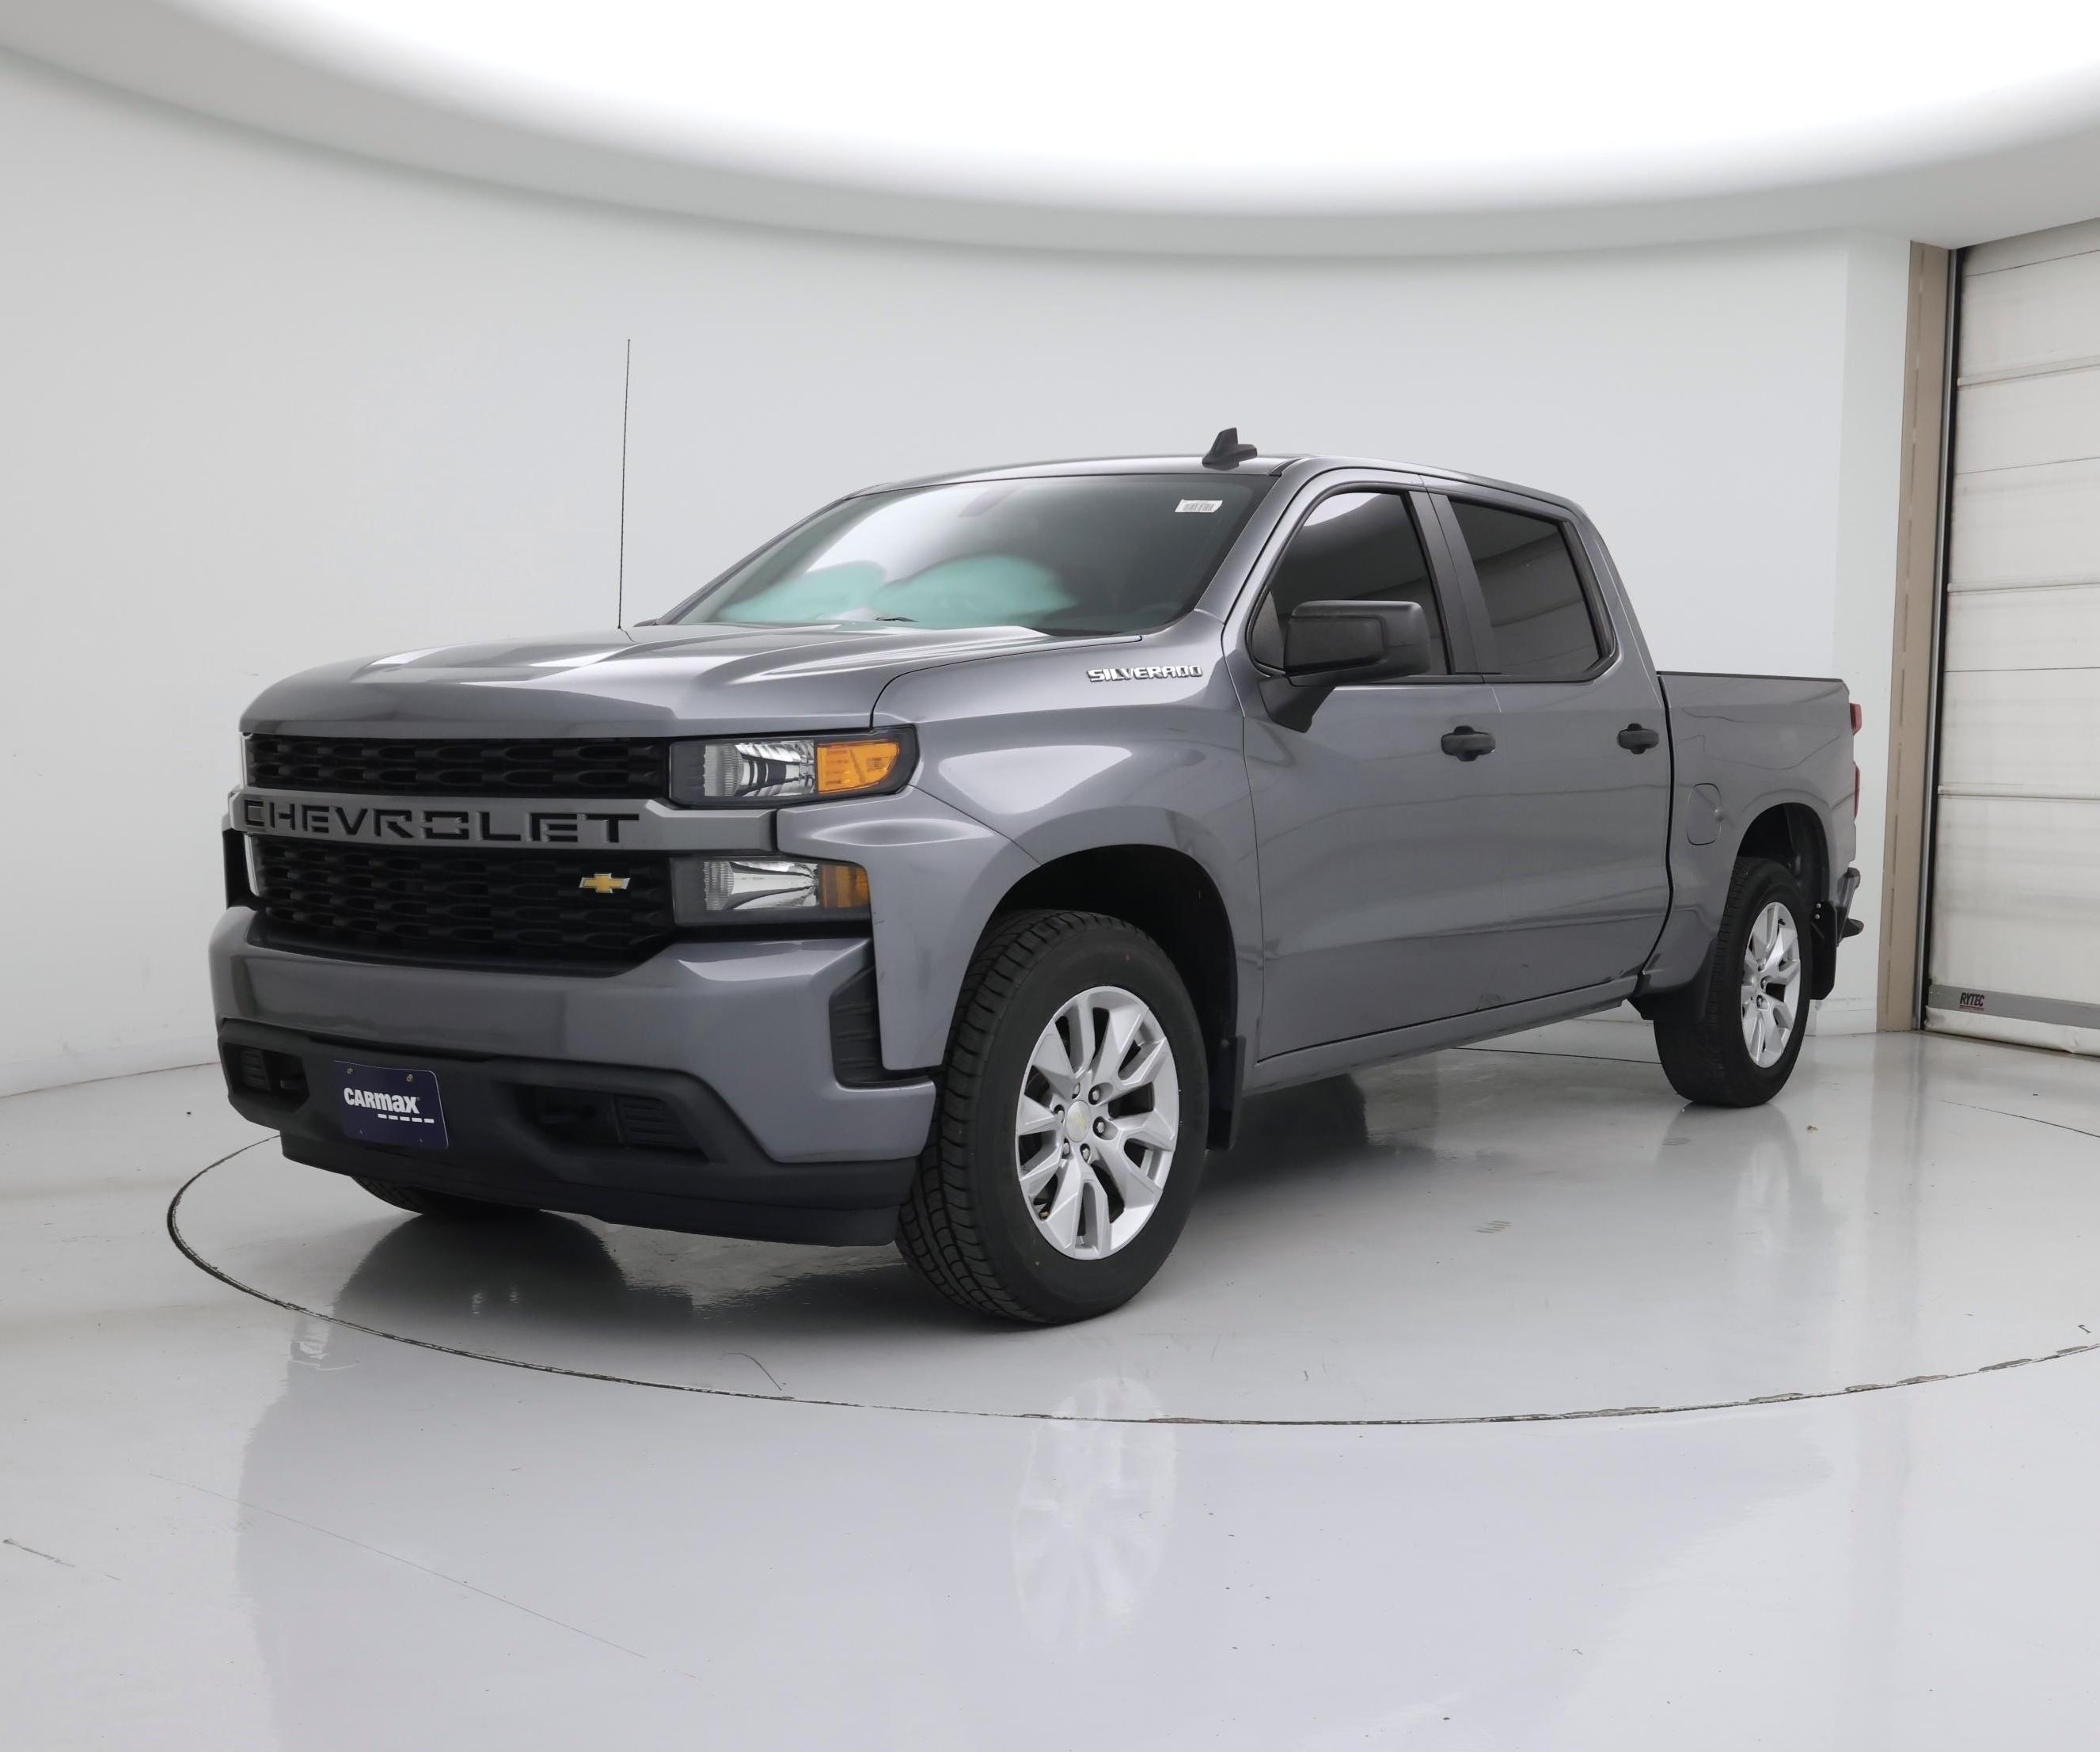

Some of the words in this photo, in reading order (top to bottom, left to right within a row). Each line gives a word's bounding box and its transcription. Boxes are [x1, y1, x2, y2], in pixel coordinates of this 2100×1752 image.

[1088, 665, 1202, 682] SILVERADO
[244, 799, 640, 843] CHEVROLET
[1959, 992, 1985, 1007] RYTEC
